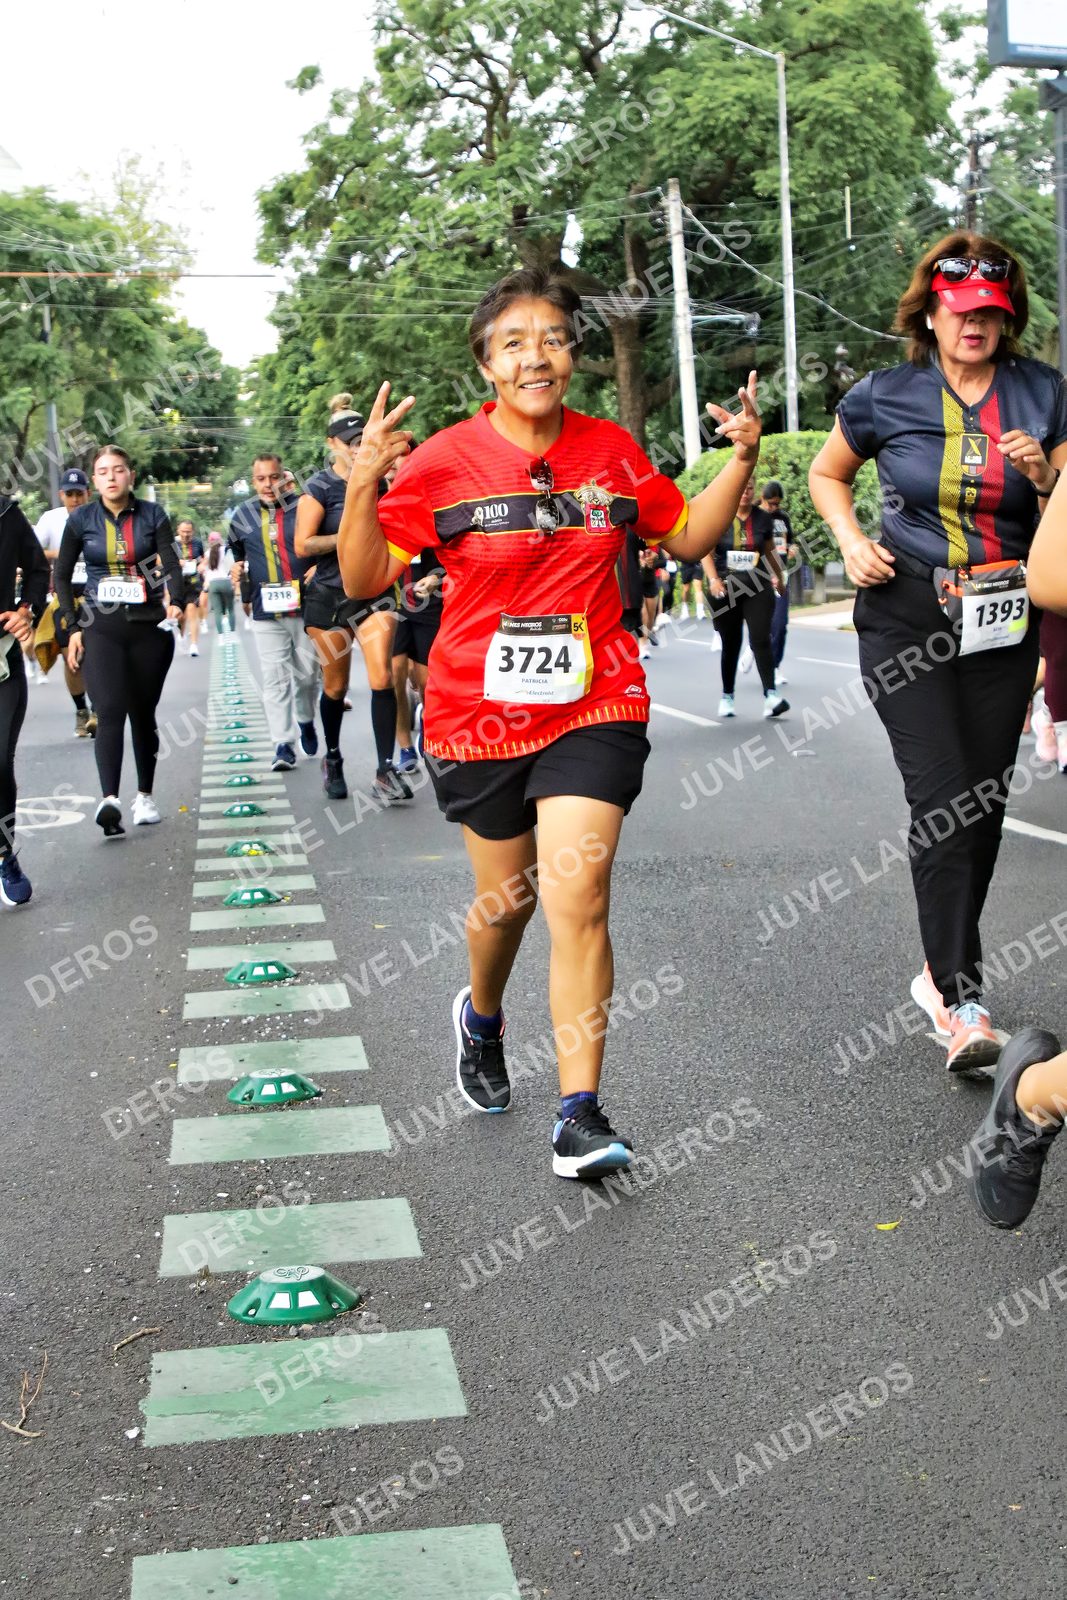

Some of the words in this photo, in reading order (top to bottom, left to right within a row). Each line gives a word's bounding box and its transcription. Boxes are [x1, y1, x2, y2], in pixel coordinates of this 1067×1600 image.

[267, 591, 292, 601] 2318
[976, 597, 1026, 628] 1393
[573, 622, 584, 632] 5K
[499, 645, 572, 674] 3724
